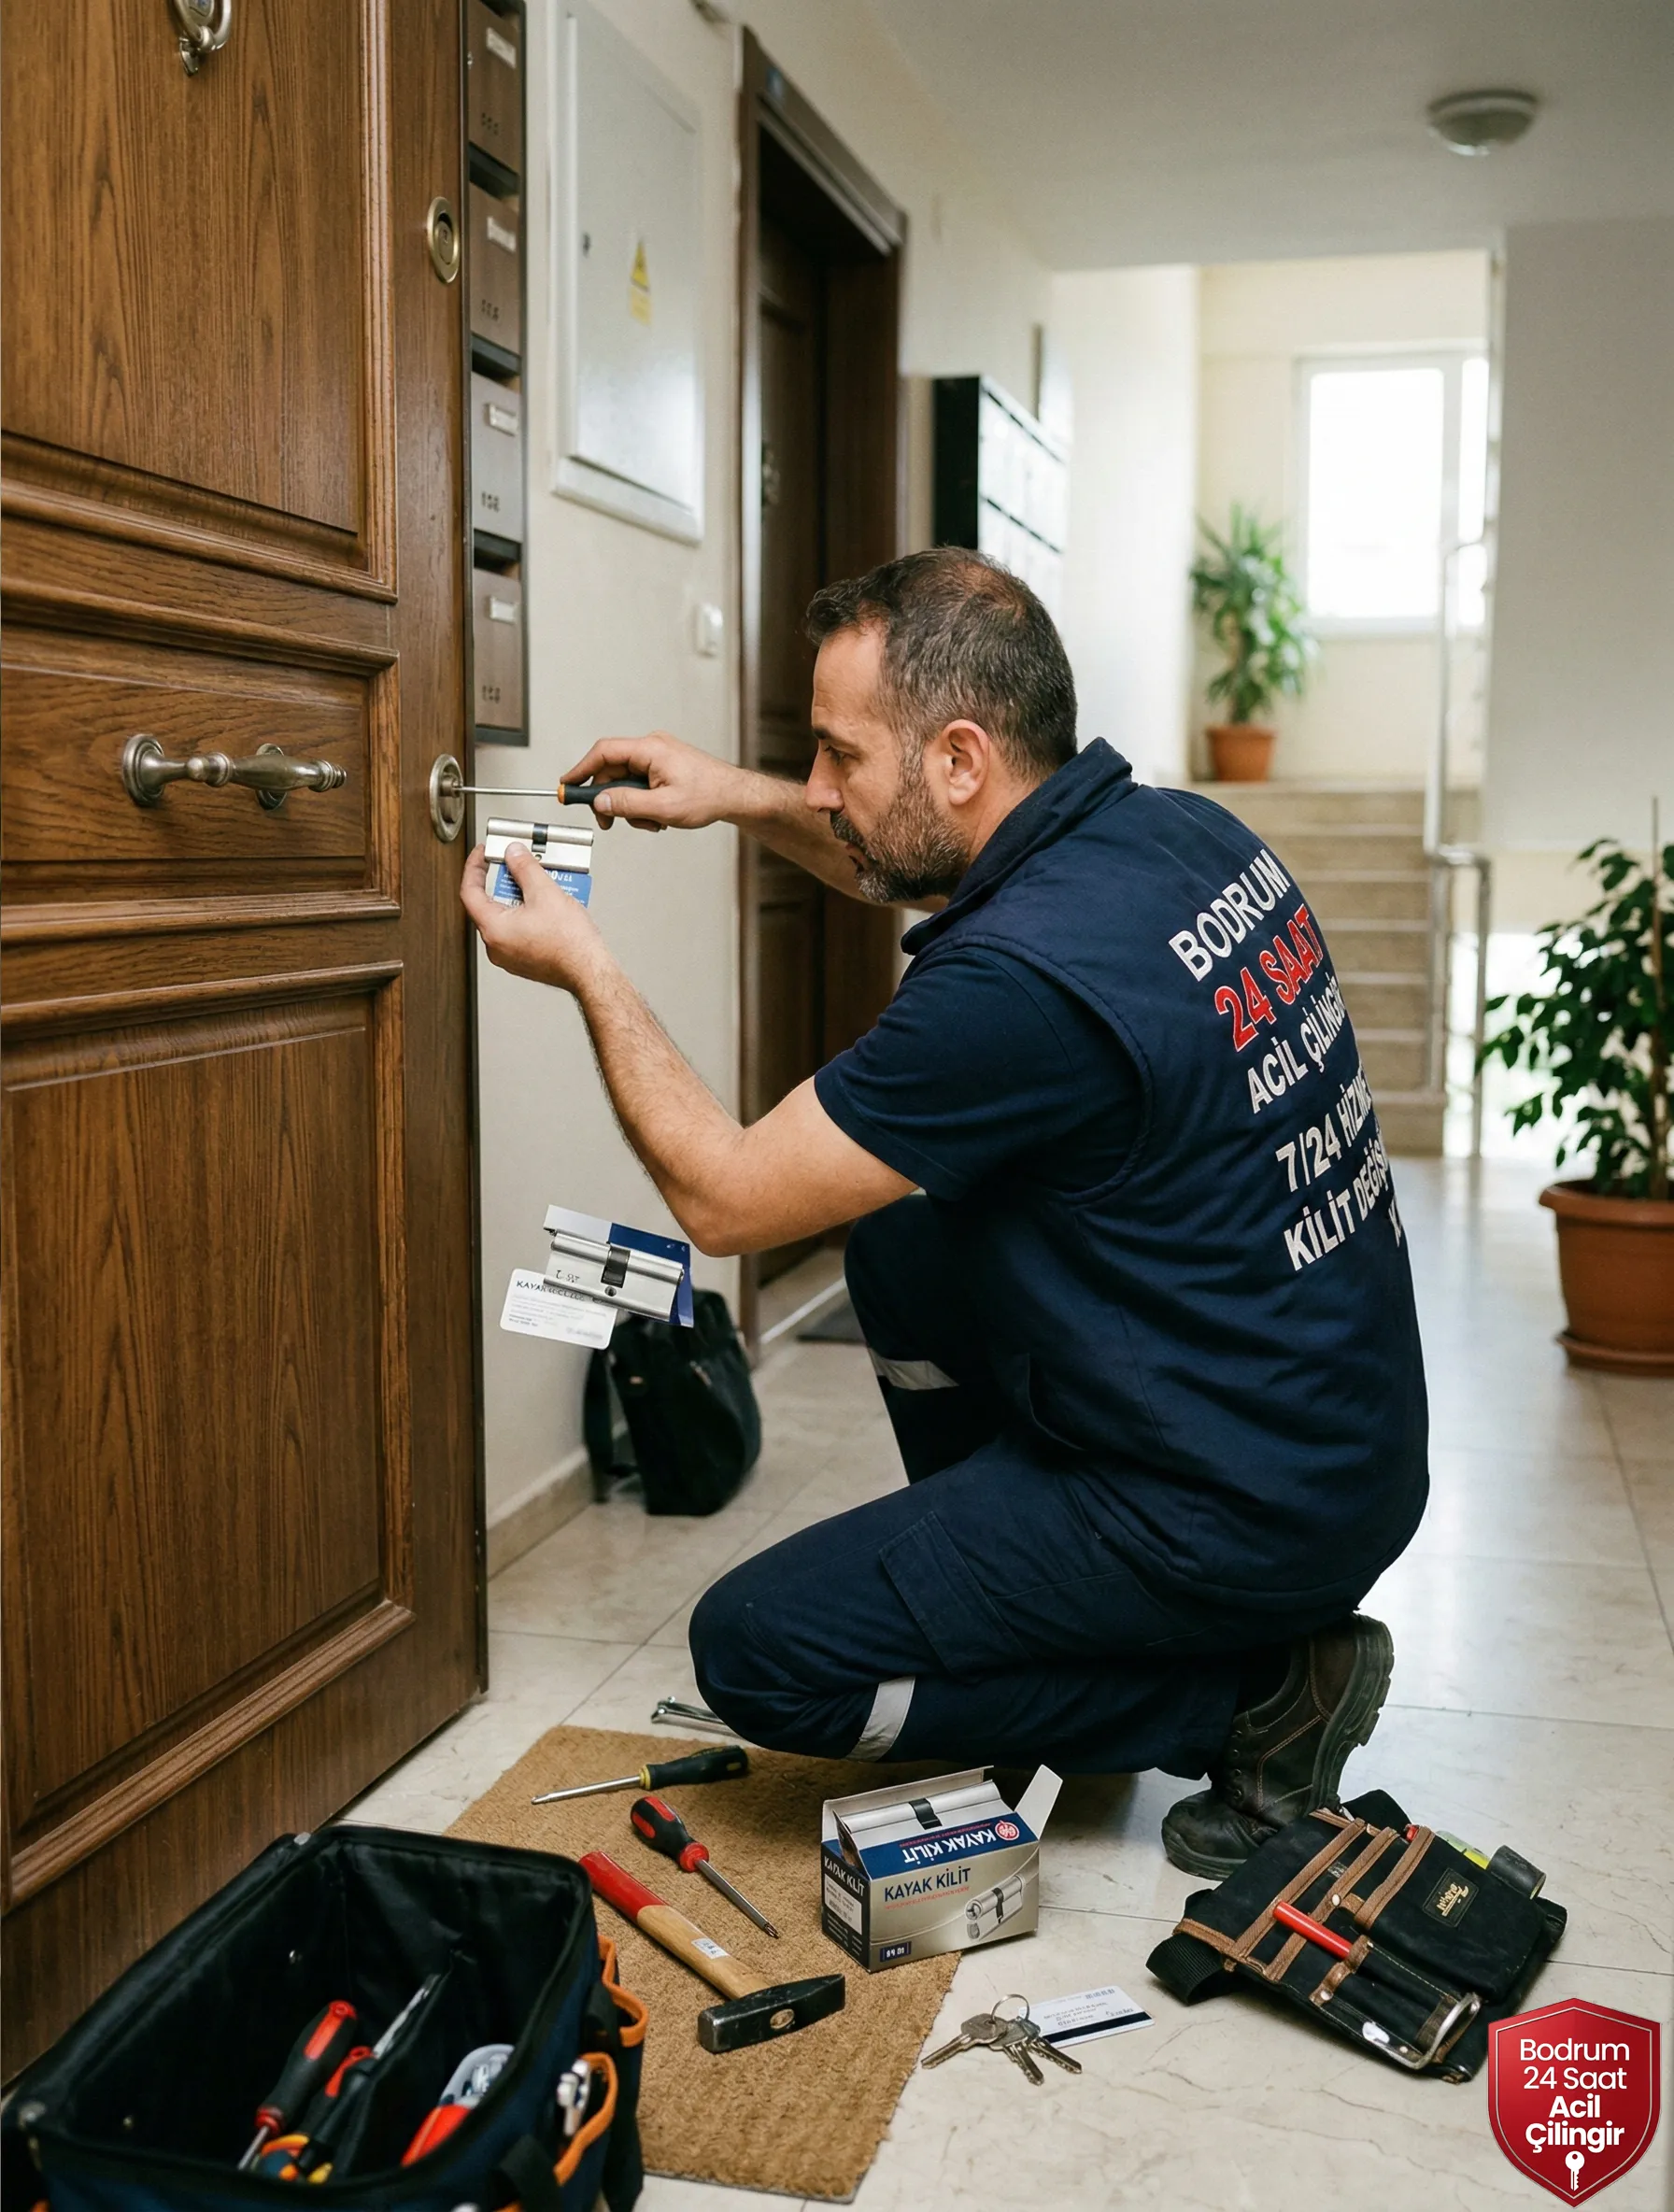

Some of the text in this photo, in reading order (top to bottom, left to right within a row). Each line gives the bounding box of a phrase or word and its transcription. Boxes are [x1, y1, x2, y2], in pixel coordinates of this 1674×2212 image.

[1169, 848, 1291, 982] BODRUM
[1214, 903, 1324, 1053] 24 SAAT
[1247, 1035, 1309, 1114] ACİL
[1275, 1113, 1341, 1193] 7/24
[1284, 1188, 1356, 1271] KİLİT
[901, 1844, 943, 1865] KİLİT
[941, 1828, 997, 1853] KAYAK
[885, 1877, 932, 1903] KAYAK
[936, 1865, 972, 1890] KİLİT
